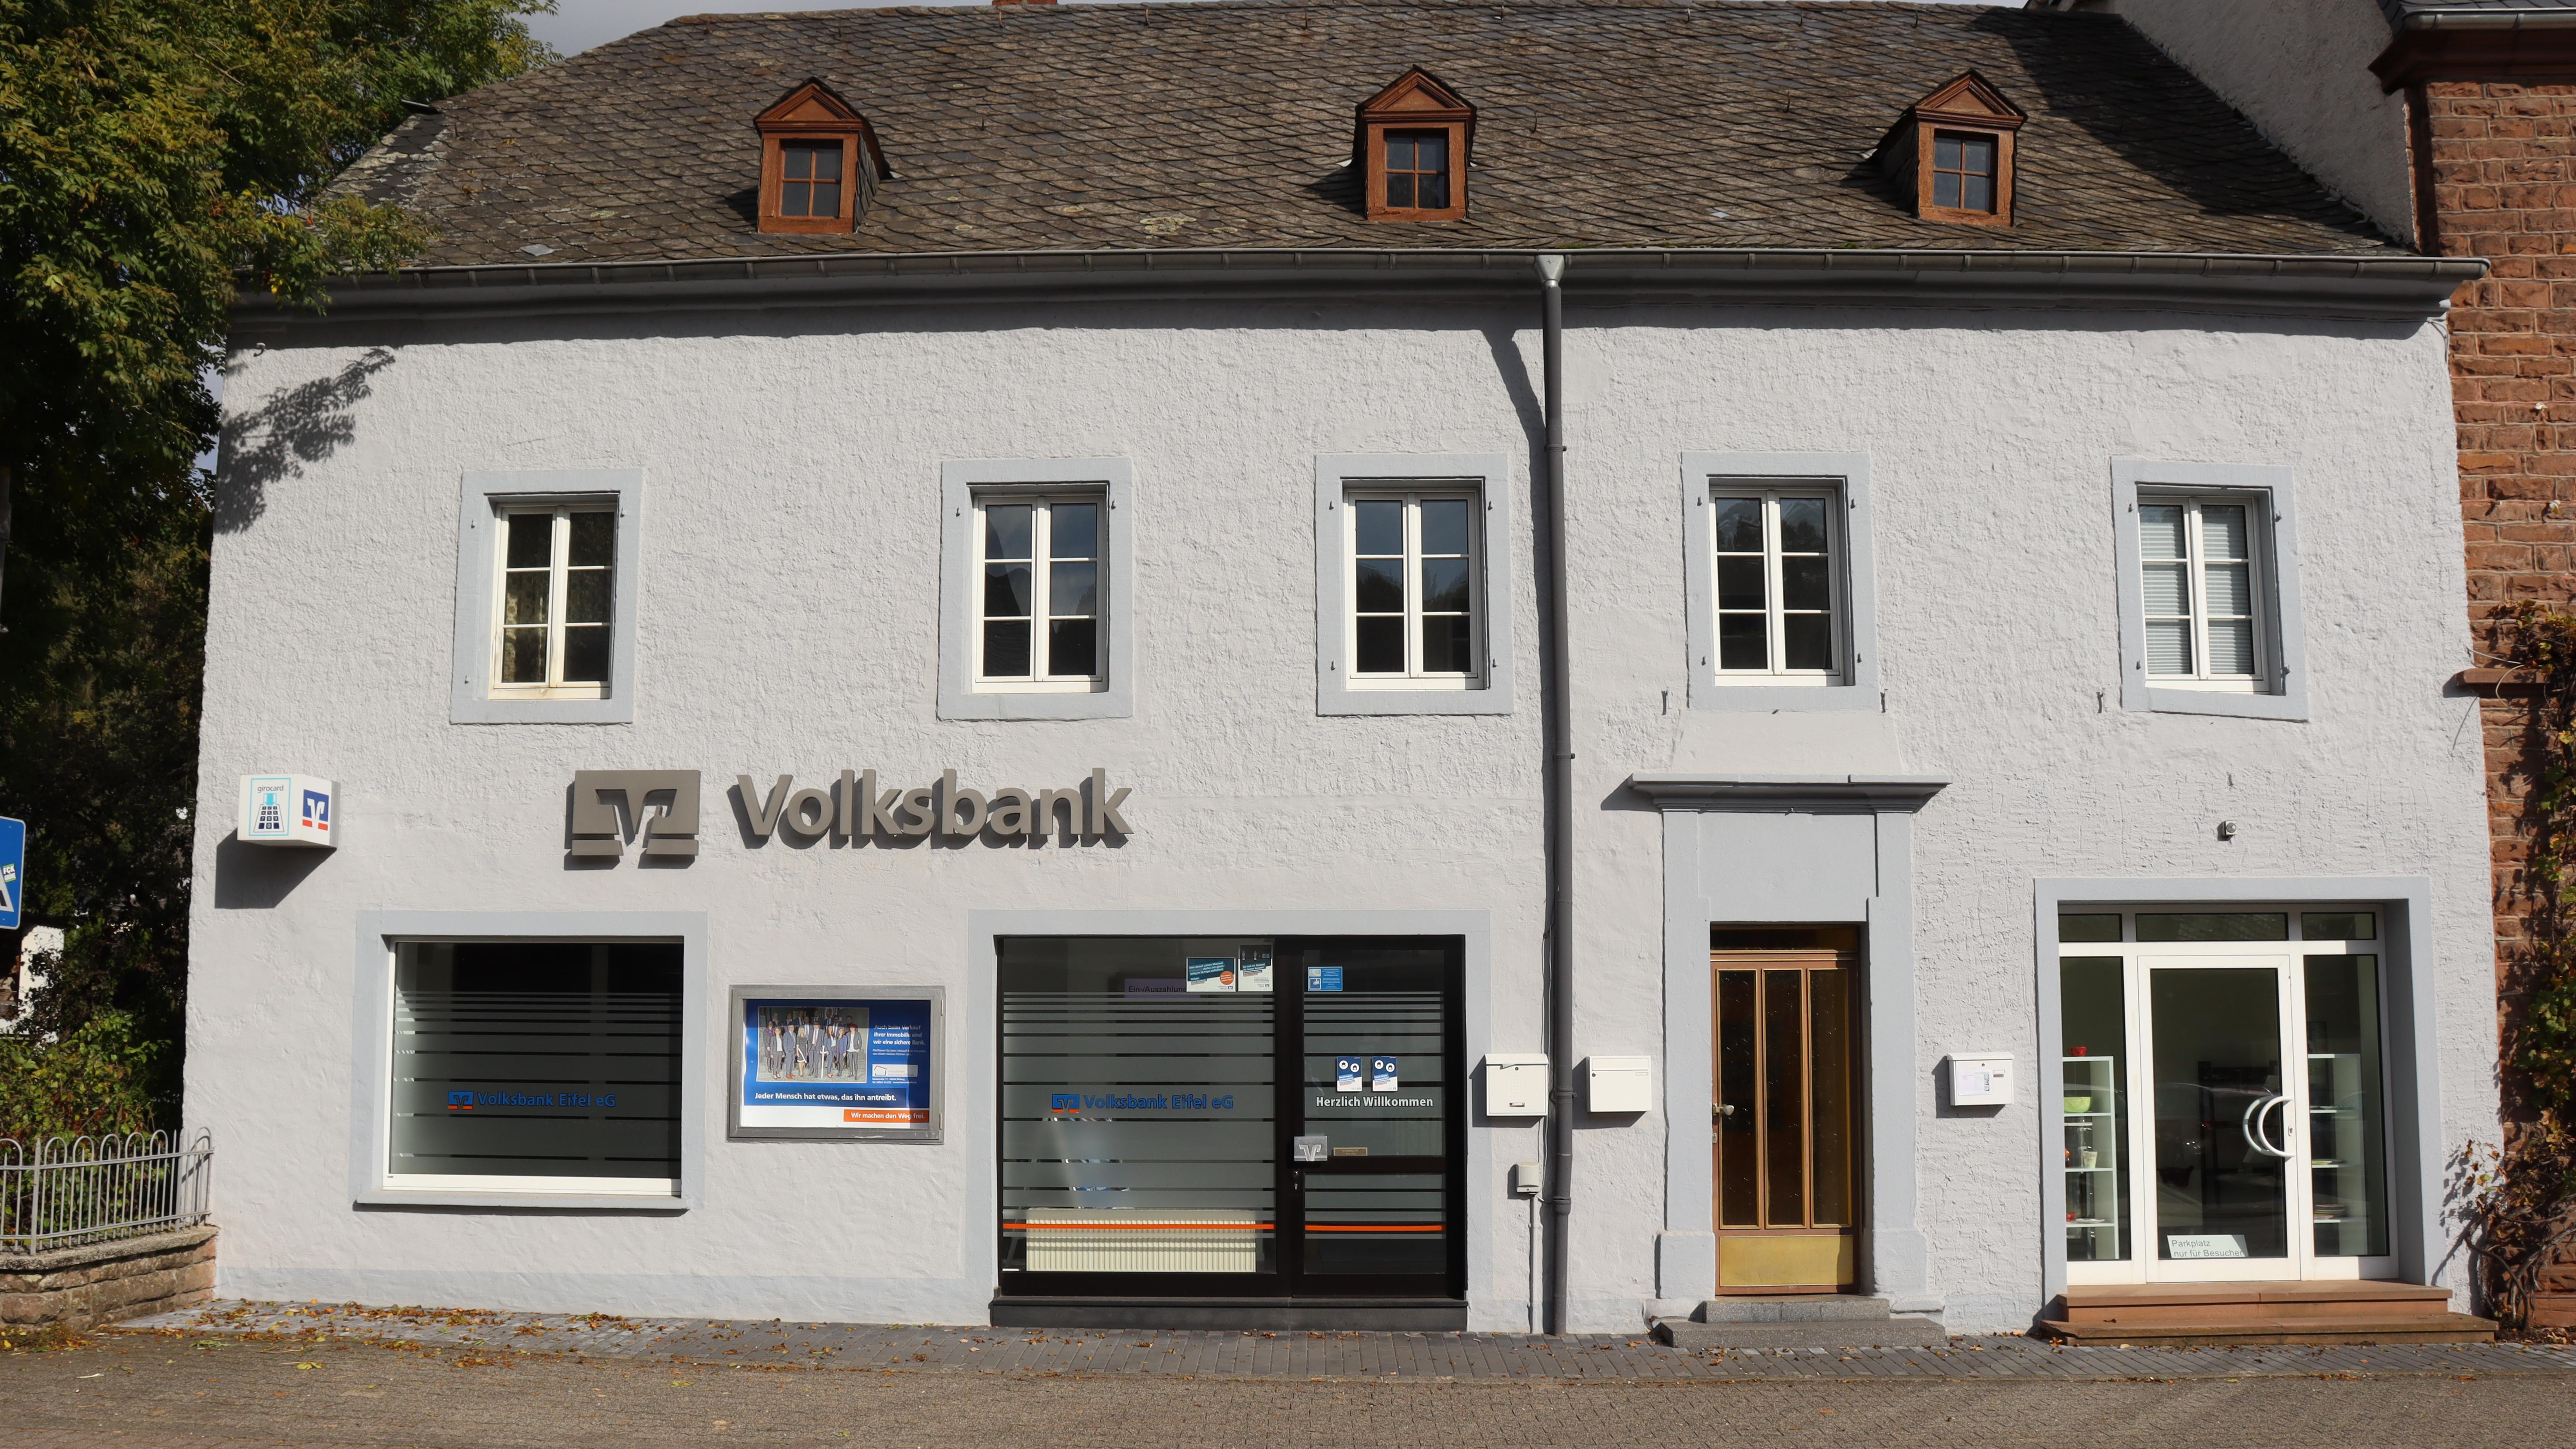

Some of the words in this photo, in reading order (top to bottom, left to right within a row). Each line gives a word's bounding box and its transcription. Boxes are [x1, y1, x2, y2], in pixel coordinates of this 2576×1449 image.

[736, 768, 1133, 836] Volksbank
[3, 865, 15, 875] FCK
[477, 1092, 554, 1106] Volksbank
[559, 1093, 591, 1107] Eifel
[595, 1094, 616, 1107] eG
[1083, 1094, 1167, 1109] Volksbank
[1172, 1094, 1206, 1109] Eifel
[1212, 1095, 1233, 1109] eG
[1316, 1096, 1361, 1107] Herzlich
[1363, 1096, 1434, 1107] Willkommen
[2172, 1239, 2211, 1249] Parkplatz
